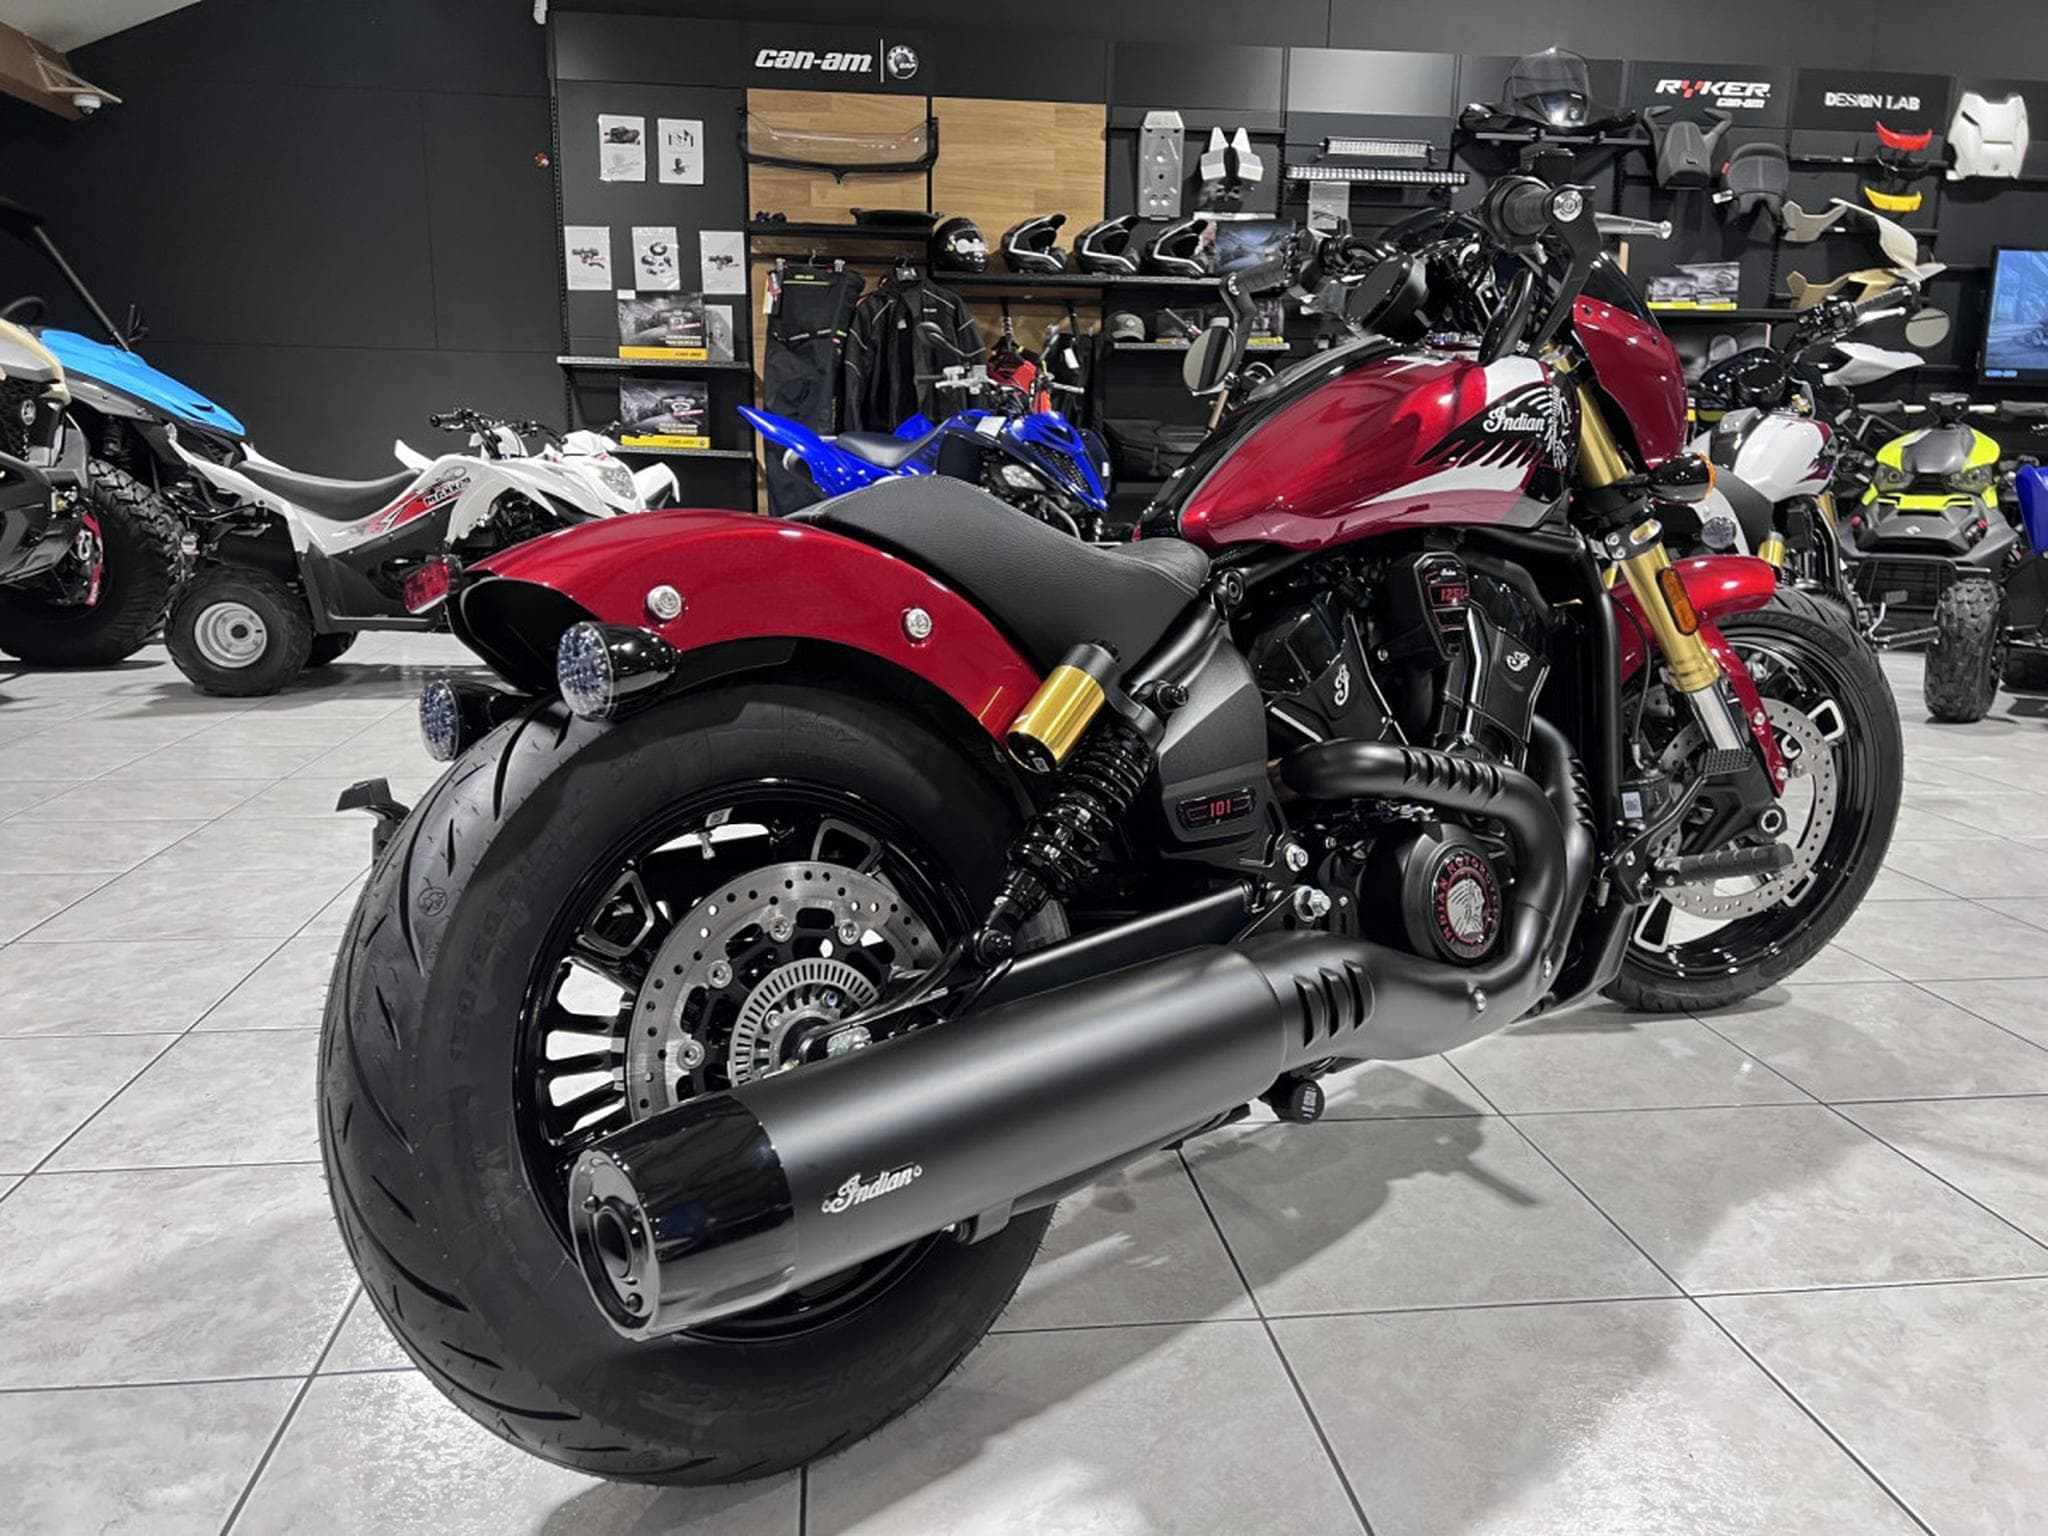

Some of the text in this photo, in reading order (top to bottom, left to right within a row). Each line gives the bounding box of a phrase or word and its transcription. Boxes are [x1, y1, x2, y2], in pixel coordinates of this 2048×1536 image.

[754, 49, 872, 73] can-am
[1655, 79, 1771, 98] RYKER
[1824, 92, 1921, 111] DESIGN LAB
[1482, 405, 1545, 433] Indian
[1210, 799, 1232, 817] 101
[828, 1167, 914, 1214] Indian
